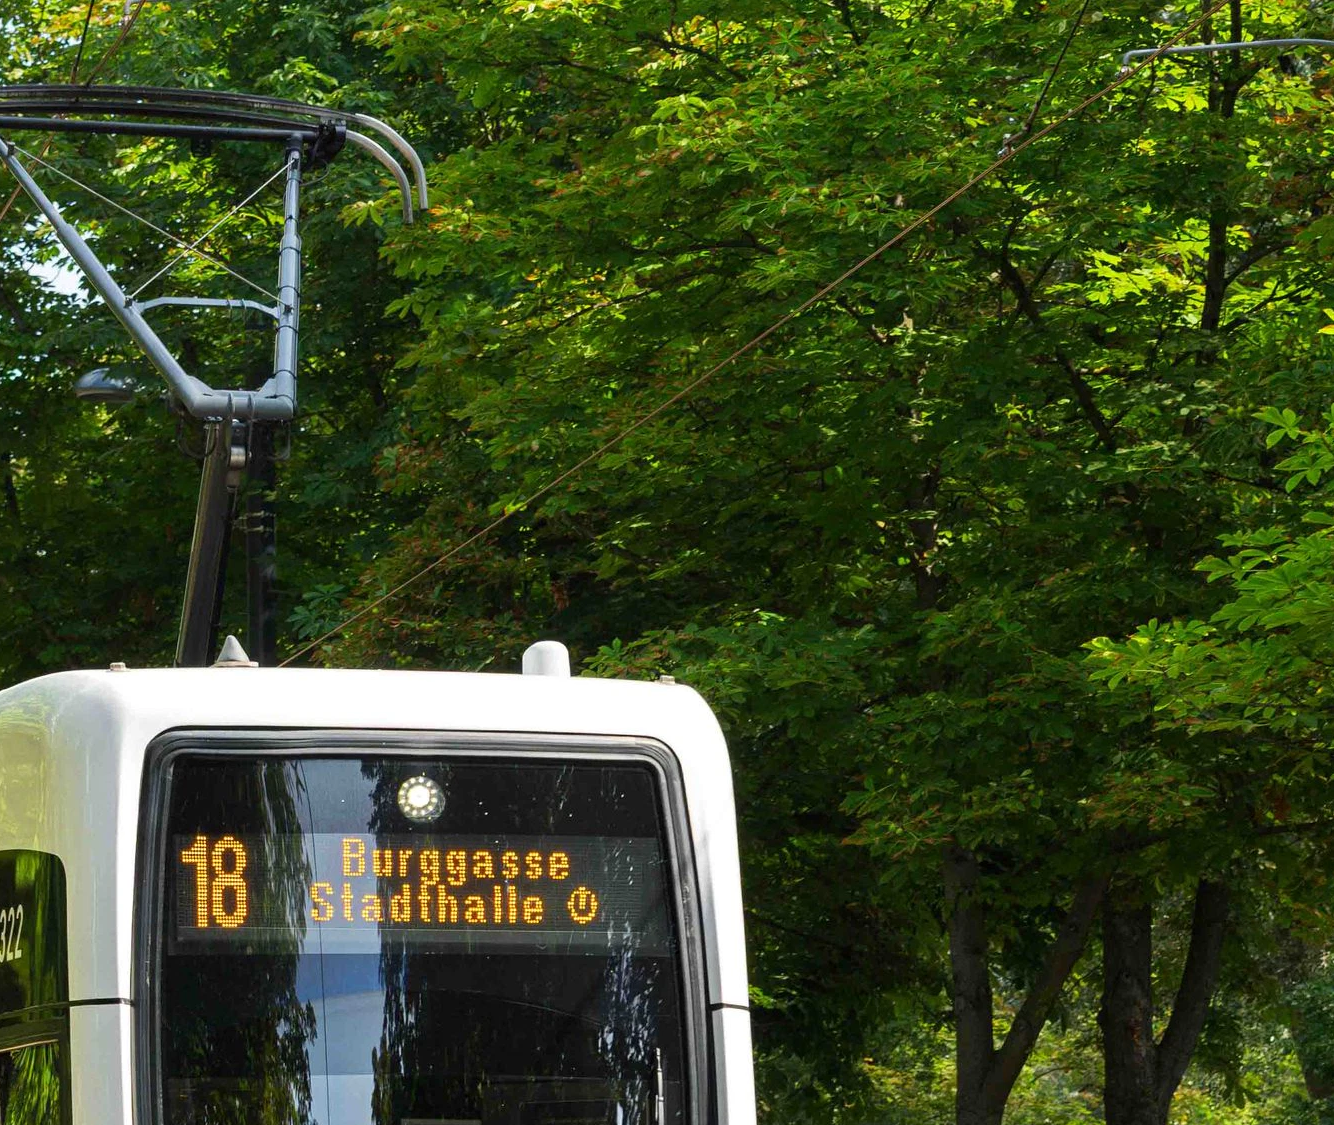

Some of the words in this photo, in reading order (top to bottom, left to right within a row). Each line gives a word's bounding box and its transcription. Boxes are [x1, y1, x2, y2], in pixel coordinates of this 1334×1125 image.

[181, 836, 247, 928] 18
[342, 838, 570, 886] Burggasse
[310, 882, 544, 924] Stadthalle
